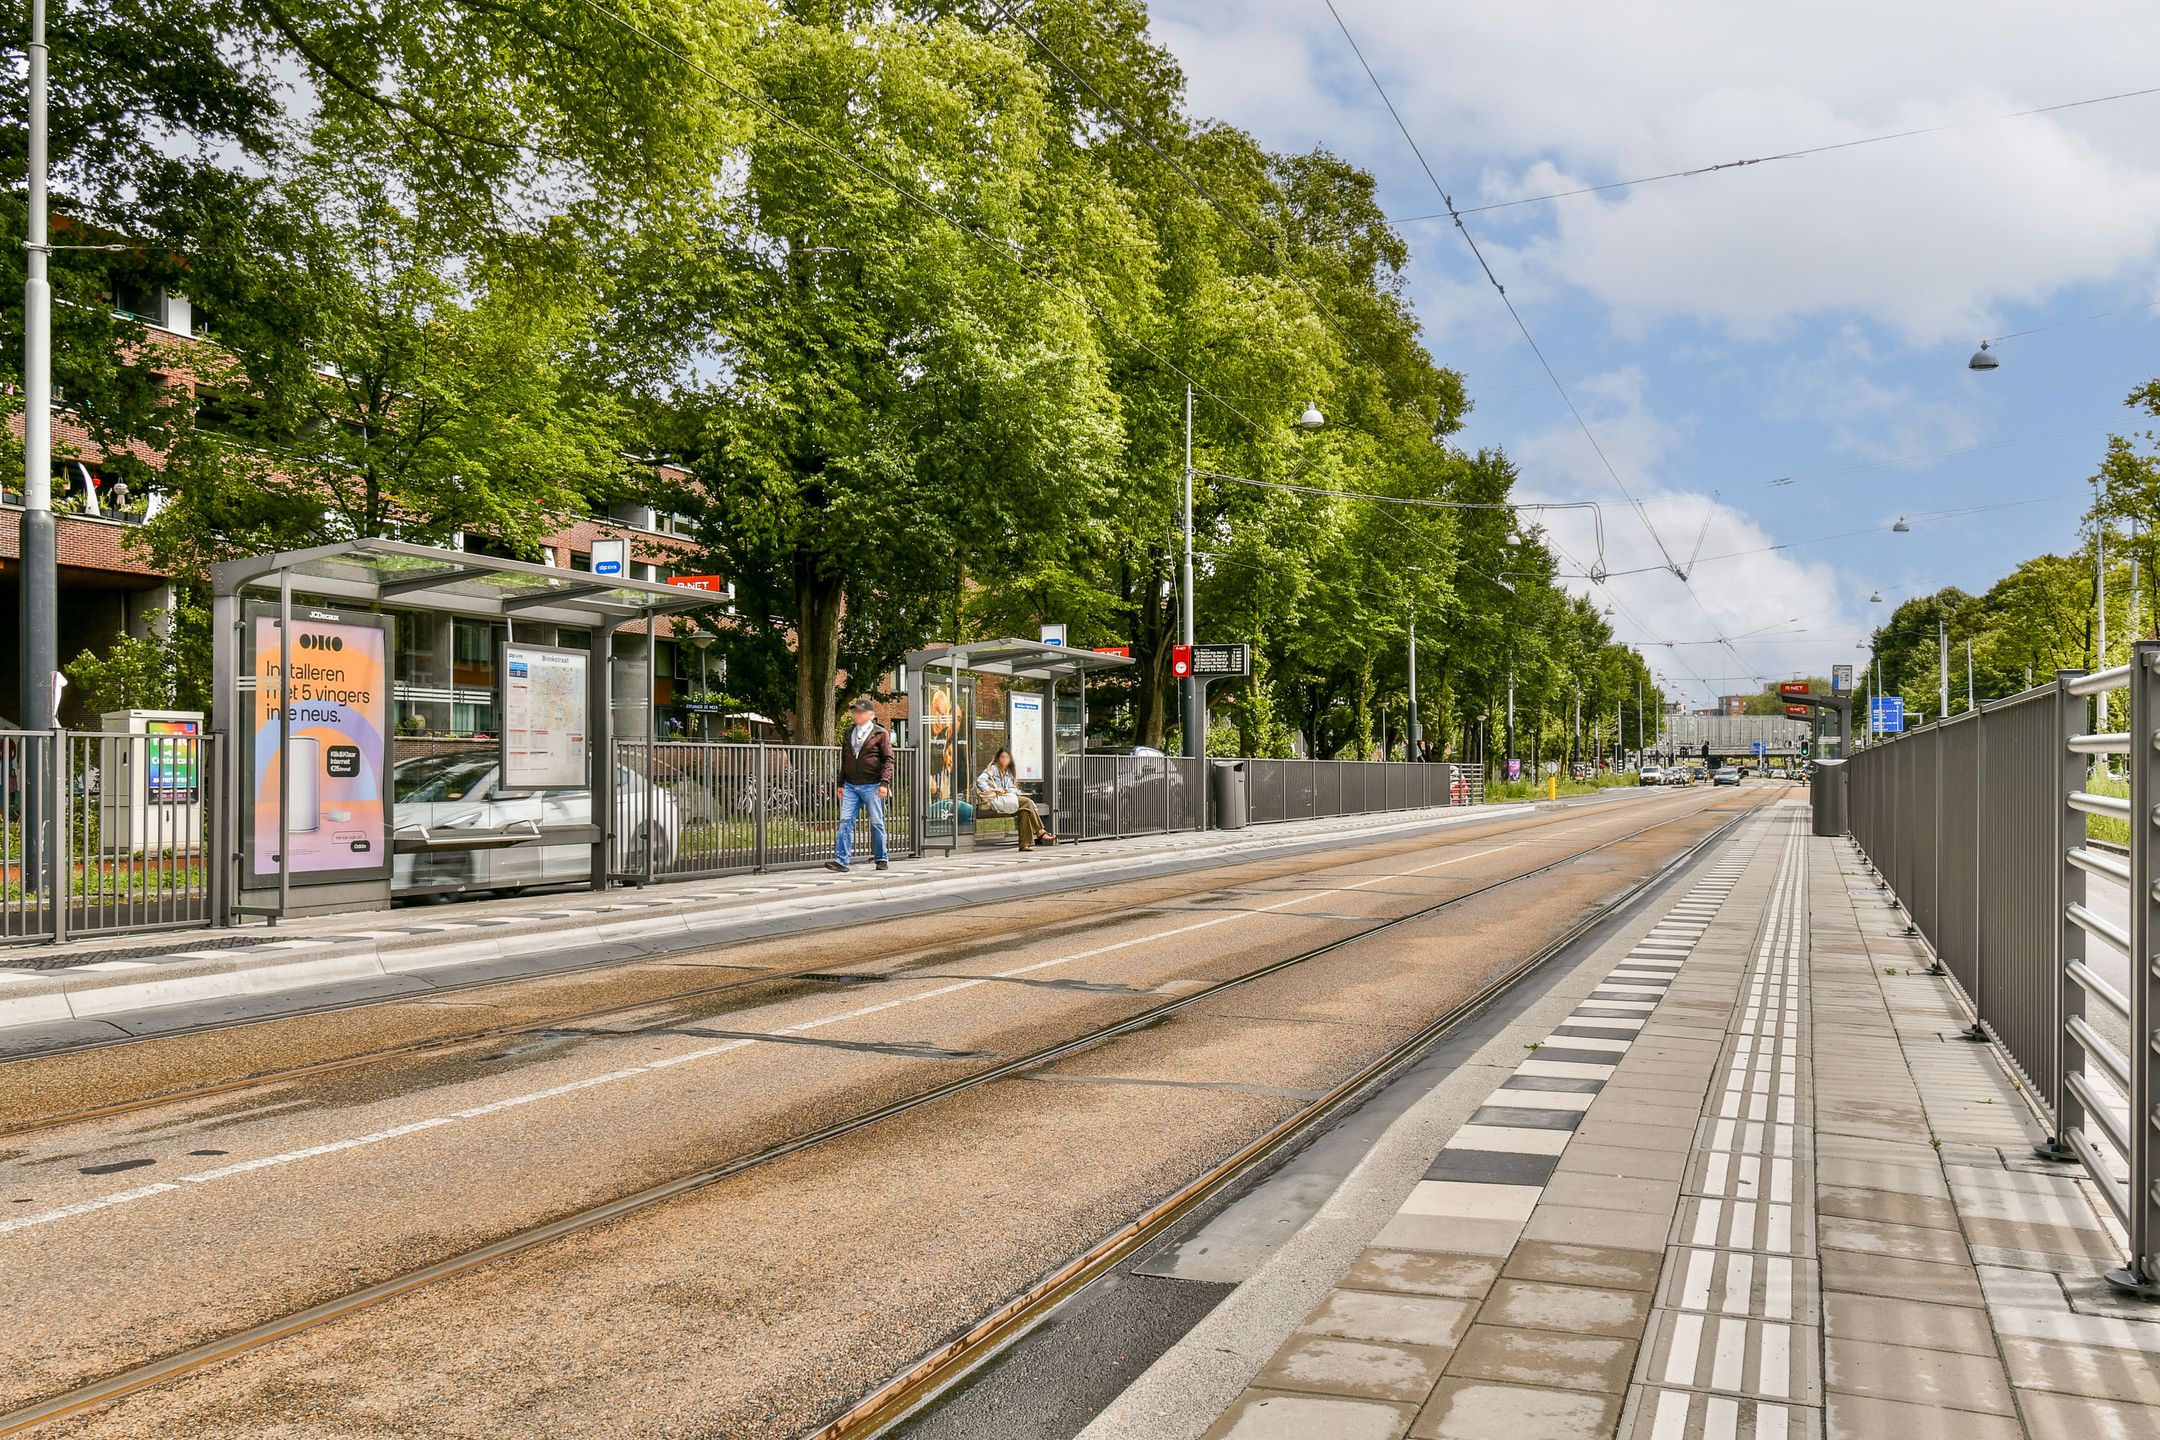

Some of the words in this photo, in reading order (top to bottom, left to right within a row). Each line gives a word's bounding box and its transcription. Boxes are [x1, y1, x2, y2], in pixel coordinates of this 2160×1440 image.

[542, 655, 569, 664] Brinkstraat
[266, 661, 344, 682] Intalleren
[302, 684, 312, 700] 5
[316, 686, 370, 706] vingers
[301, 708, 341, 722] neus.
